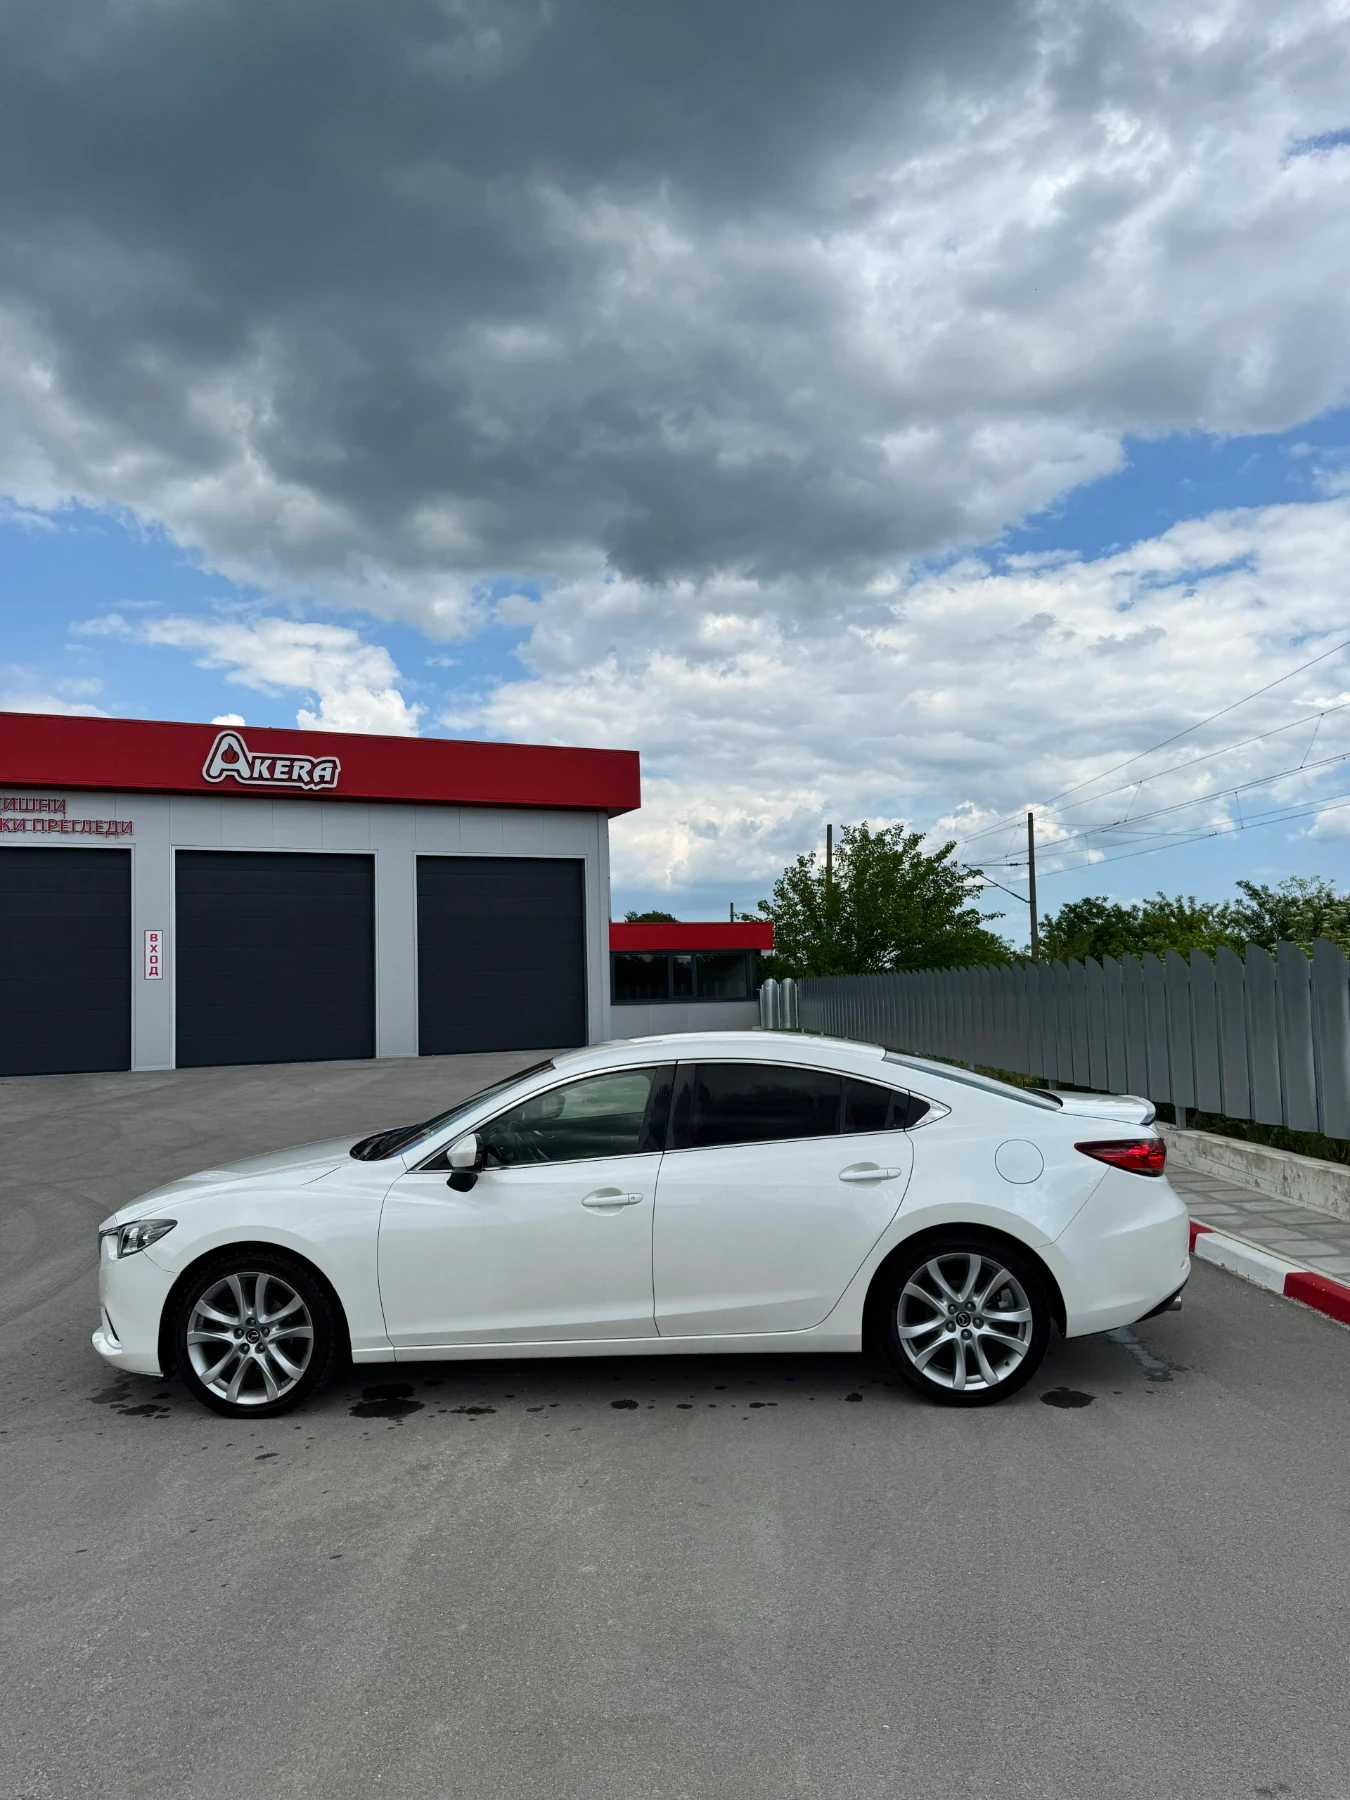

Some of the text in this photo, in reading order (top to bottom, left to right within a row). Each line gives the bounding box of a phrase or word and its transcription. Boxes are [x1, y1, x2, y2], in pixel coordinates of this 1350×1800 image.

[206, 733, 336, 785] AKERA
[0, 797, 66, 814] ИШНИ
[32, 818, 134, 838] ПРЕГЛЕДИ
[149, 933, 159, 977] ВХОД
